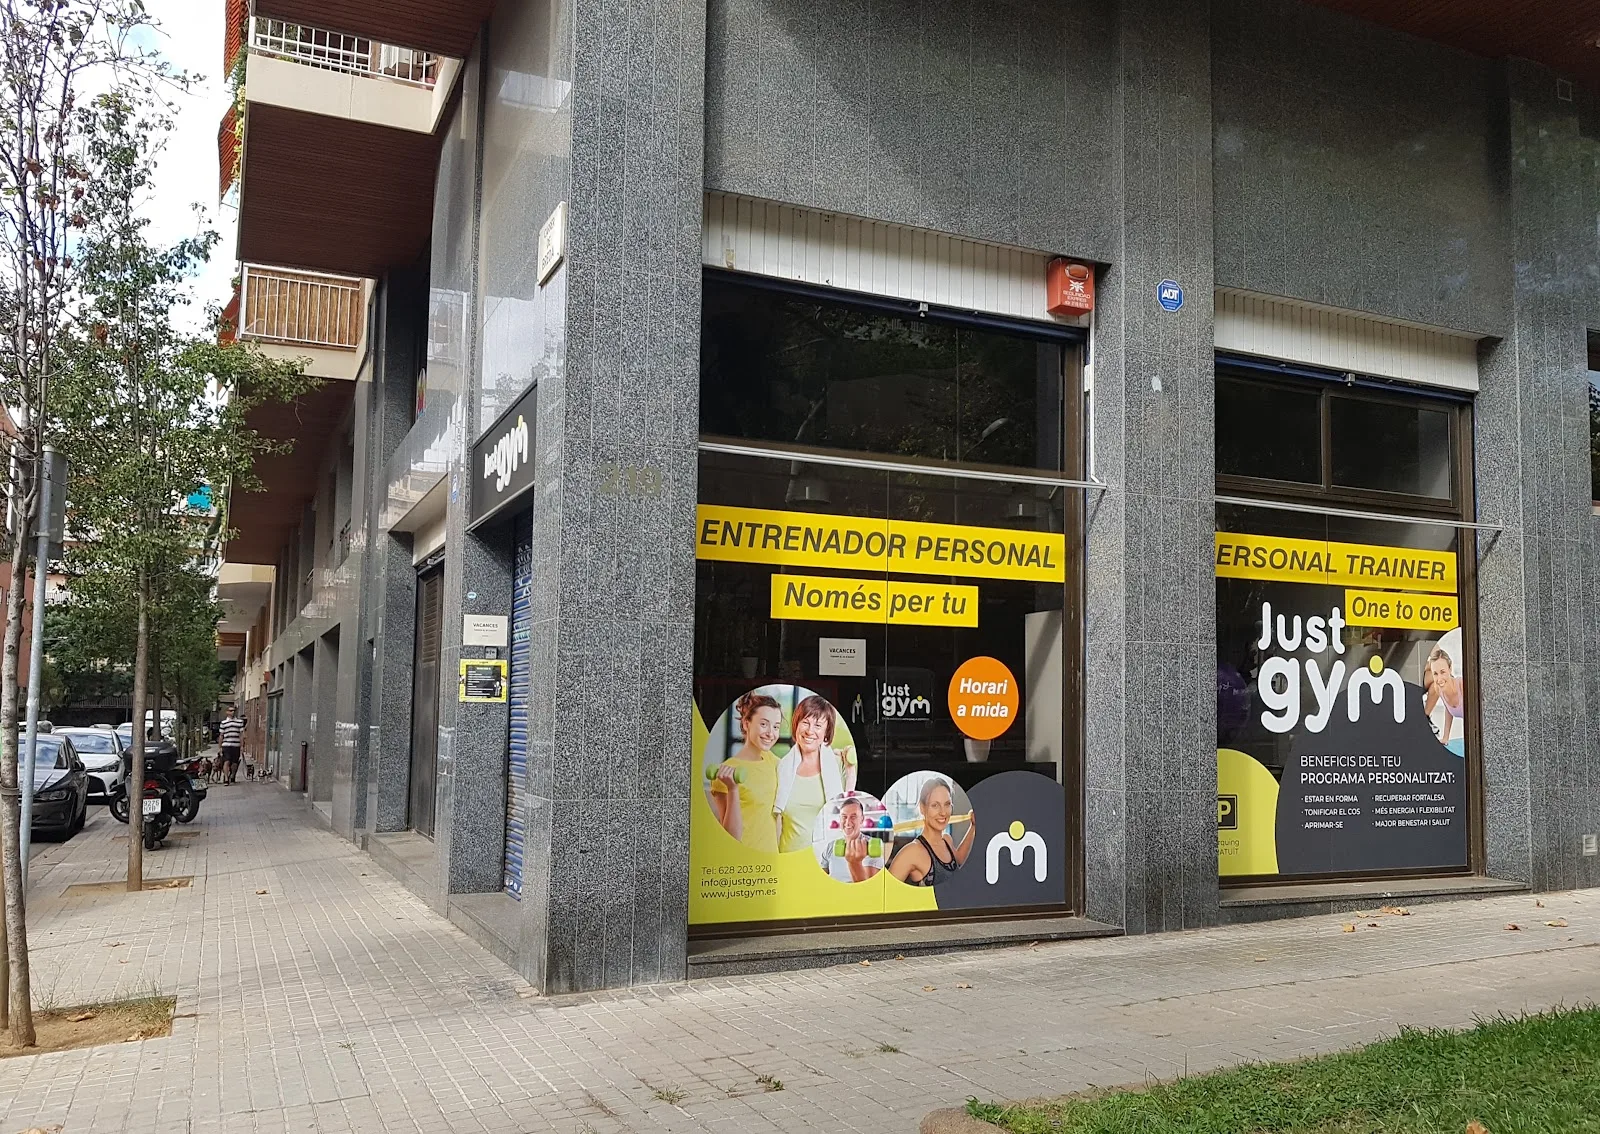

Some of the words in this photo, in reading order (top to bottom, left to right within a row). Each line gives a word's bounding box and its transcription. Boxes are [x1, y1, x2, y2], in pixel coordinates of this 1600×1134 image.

[1162, 289, 1178, 300] ADT
[496, 414, 528, 493] gym
[700, 519, 907, 559] ENTRENADOR
[915, 535, 1056, 569] PERSONAL
[1216, 544, 1338, 573] ERSONAL
[1346, 554, 1446, 581] TRAINER
[784, 581, 882, 611] Només
[889, 592, 935, 618] per
[942, 592, 967, 615] tu
[1352, 596, 1390, 617] One
[1396, 600, 1414, 620] to
[1419, 605, 1453, 623] one
[1257, 602, 1346, 654] Just
[881, 683, 910, 696] Just
[959, 678, 1008, 695] Horari
[1258, 655, 1406, 733] gym
[881, 696, 931, 717] gym
[957, 703, 967, 717] a
[971, 702, 1009, 718] mida
[1300, 755, 1357, 767] BENEFICIS
[1358, 755, 1379, 767] DEL
[1381, 755, 1402, 767] TEU
[1300, 772, 1366, 784] PROGRAMA
[1368, 772, 1456, 784] PERSONALITZAT:
[1304, 795, 1325, 803] ESTAR
[1325, 795, 1335, 803] EN
[1375, 794, 1411, 802] RECUPERAR
[1218, 800, 1231, 823] P
[1304, 808, 1338, 816] TONIFICAR
[1339, 808, 1347, 816] EL
[1347, 807, 1361, 815] COS
[1375, 806, 1388, 815] MÉS
[1419, 806, 1456, 814] FLEXIBILITAT
[1304, 821, 1344, 829] APRIMAR-SE
[1375, 820, 1397, 828] MAJOR
[1397, 819, 1428, 827] BENESTAR
[1432, 818, 1450, 826] SALUT
[701, 866, 716, 875] Tel:
[718, 866, 735, 875] 628
[737, 865, 754, 874] 203
[755, 864, 772, 873] 920
[701, 876, 778, 888] info@justgym.es
[700, 888, 777, 900] www.justgym.es
